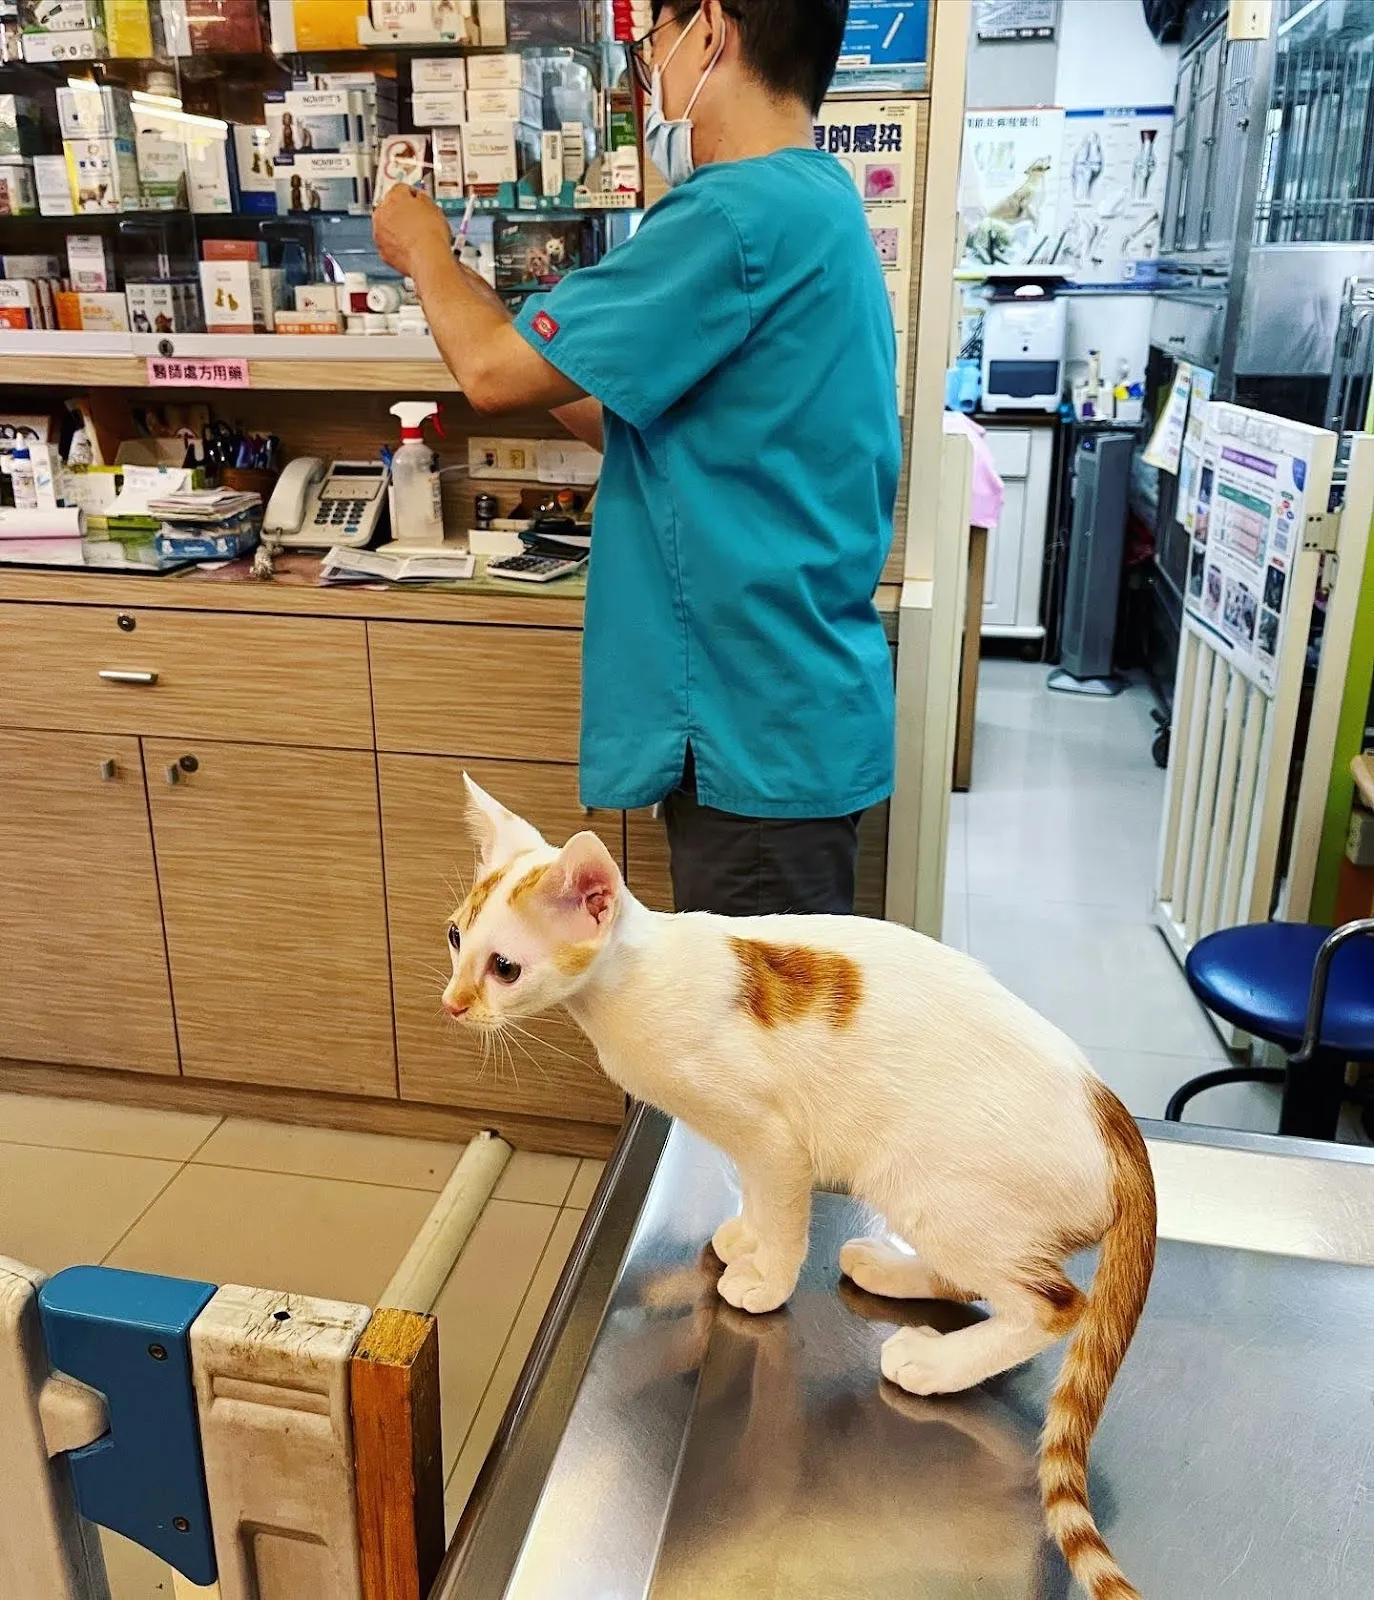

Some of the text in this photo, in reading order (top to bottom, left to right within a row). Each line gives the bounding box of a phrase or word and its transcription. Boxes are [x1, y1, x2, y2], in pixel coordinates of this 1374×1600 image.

[152, 364, 243, 381] 醫師處方用藥
